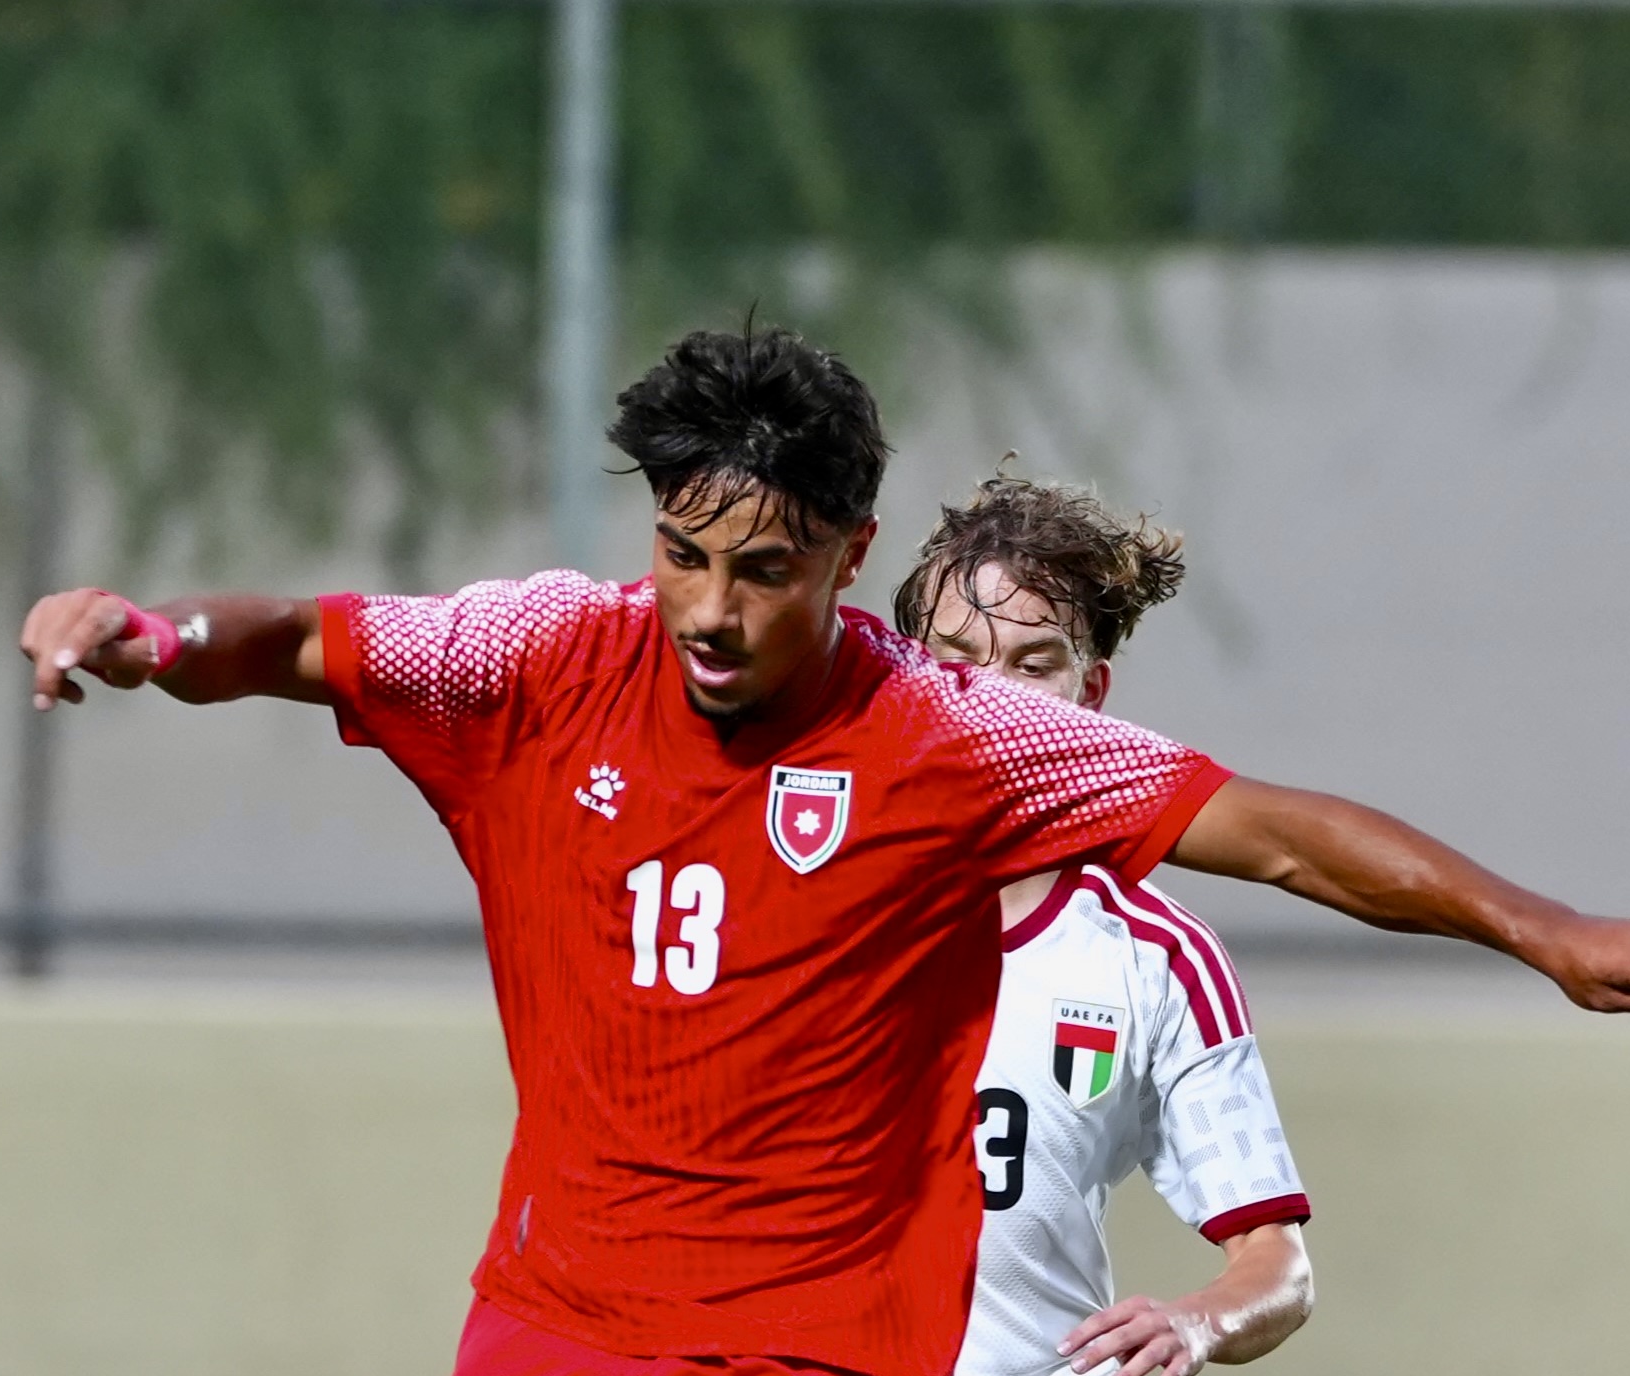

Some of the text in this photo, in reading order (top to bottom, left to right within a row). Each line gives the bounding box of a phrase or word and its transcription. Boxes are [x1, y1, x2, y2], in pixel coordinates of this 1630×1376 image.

[783, 774, 840, 791] JORDAN
[626, 860, 725, 996] 13
[1061, 1007, 1114, 1025] UAE FA
[976, 1087, 1028, 1211] 3
